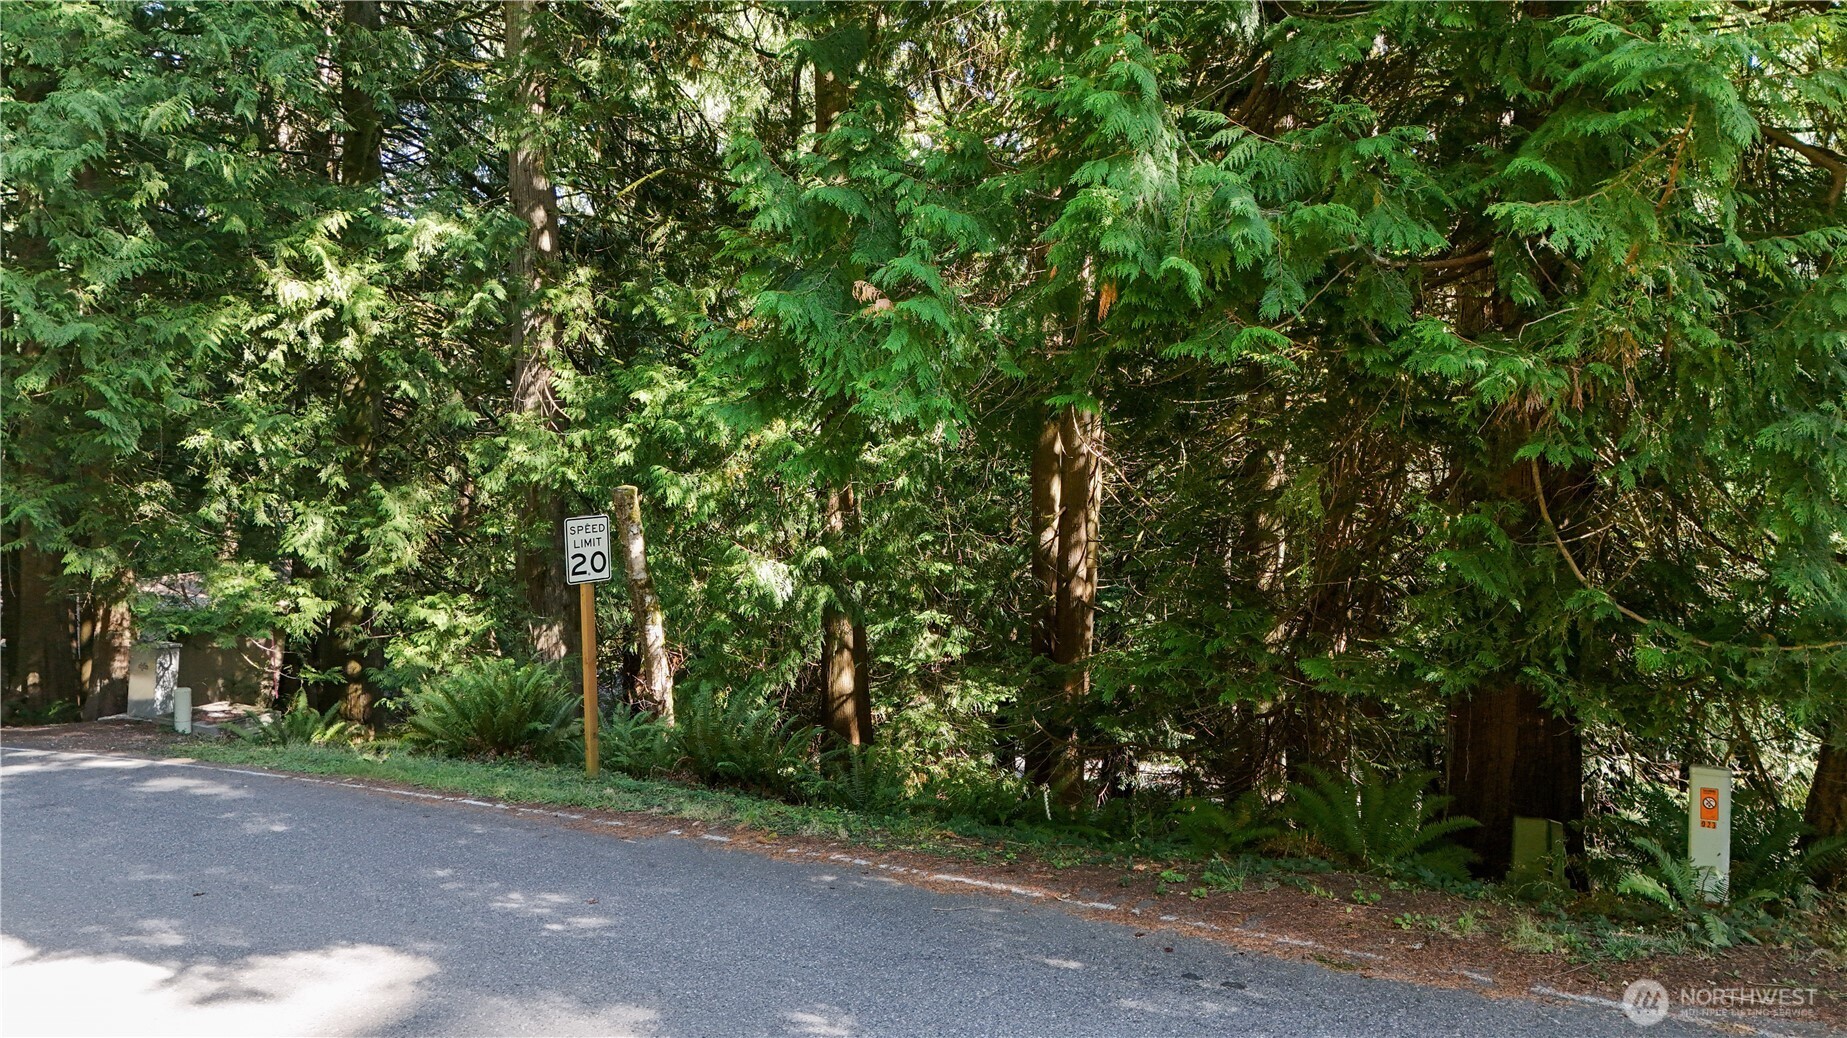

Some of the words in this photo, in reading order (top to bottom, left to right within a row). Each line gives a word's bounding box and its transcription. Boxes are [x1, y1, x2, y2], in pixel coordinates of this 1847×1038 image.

[570, 523, 605, 535] SPEED
[574, 537, 601, 548] LIMIT
[571, 551, 607, 576] 20
